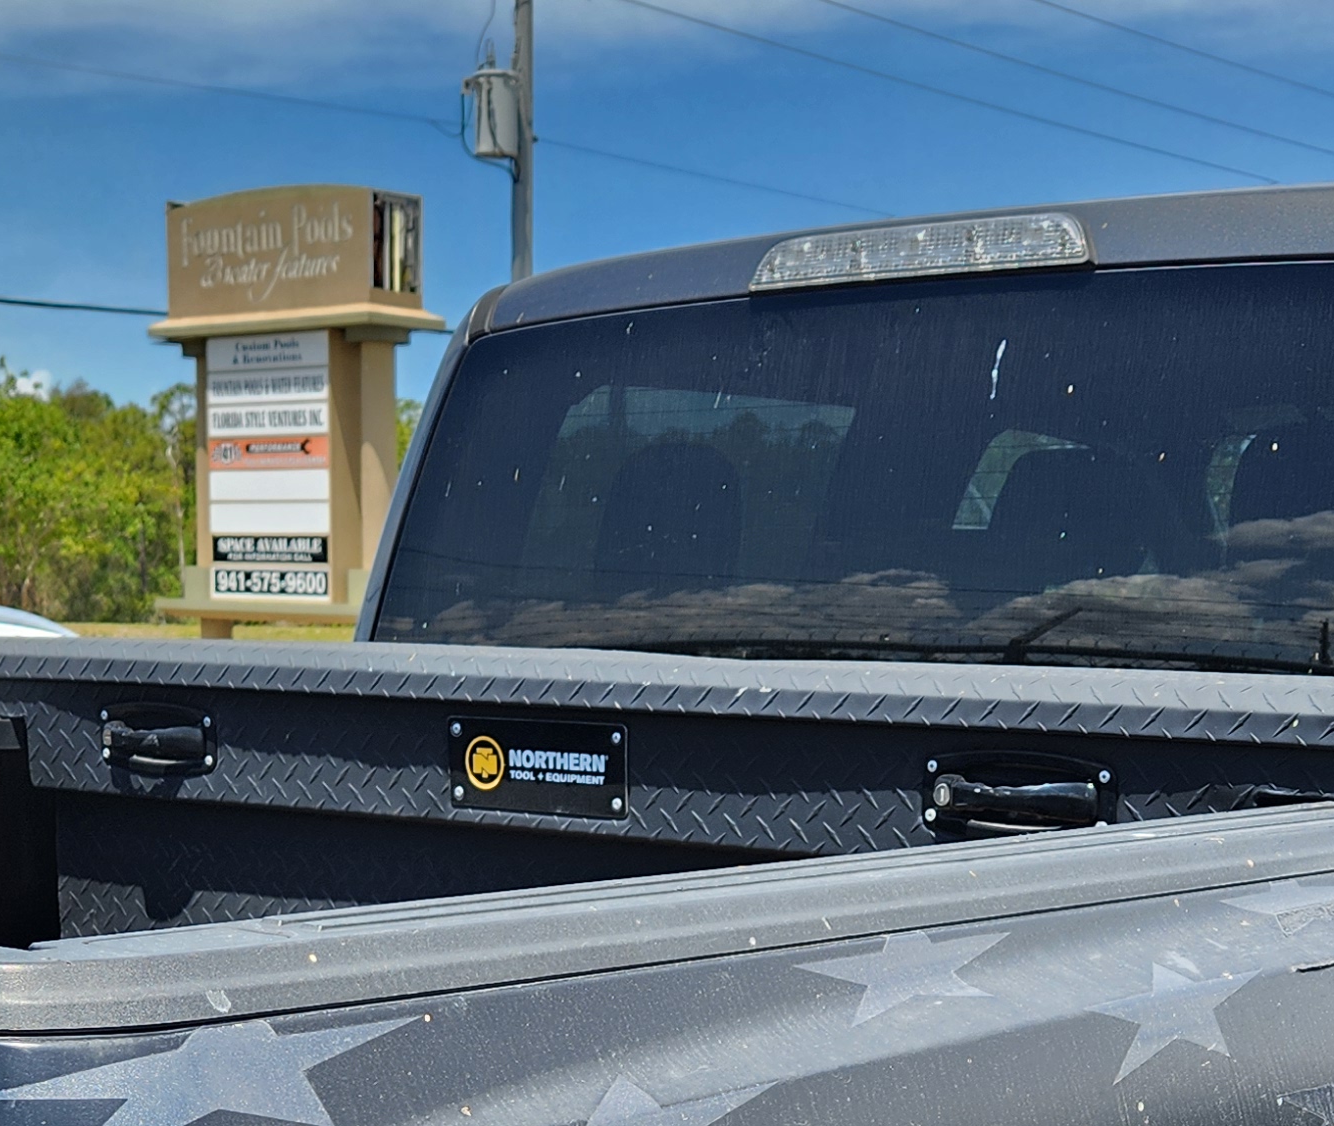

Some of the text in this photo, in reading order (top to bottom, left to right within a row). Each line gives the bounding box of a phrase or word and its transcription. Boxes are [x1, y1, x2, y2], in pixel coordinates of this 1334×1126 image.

[292, 201, 354, 256] Pools
[212, 410, 243, 429] FLORIDA
[245, 410, 266, 428] STYLE
[268, 408, 307, 428] VENTURES
[217, 537, 322, 553] SPACE AVAILABLE
[508, 749, 606, 773] NORTHERN
[509, 769, 536, 781] TOOL
[545, 772, 605, 785] EQUIPMENT
